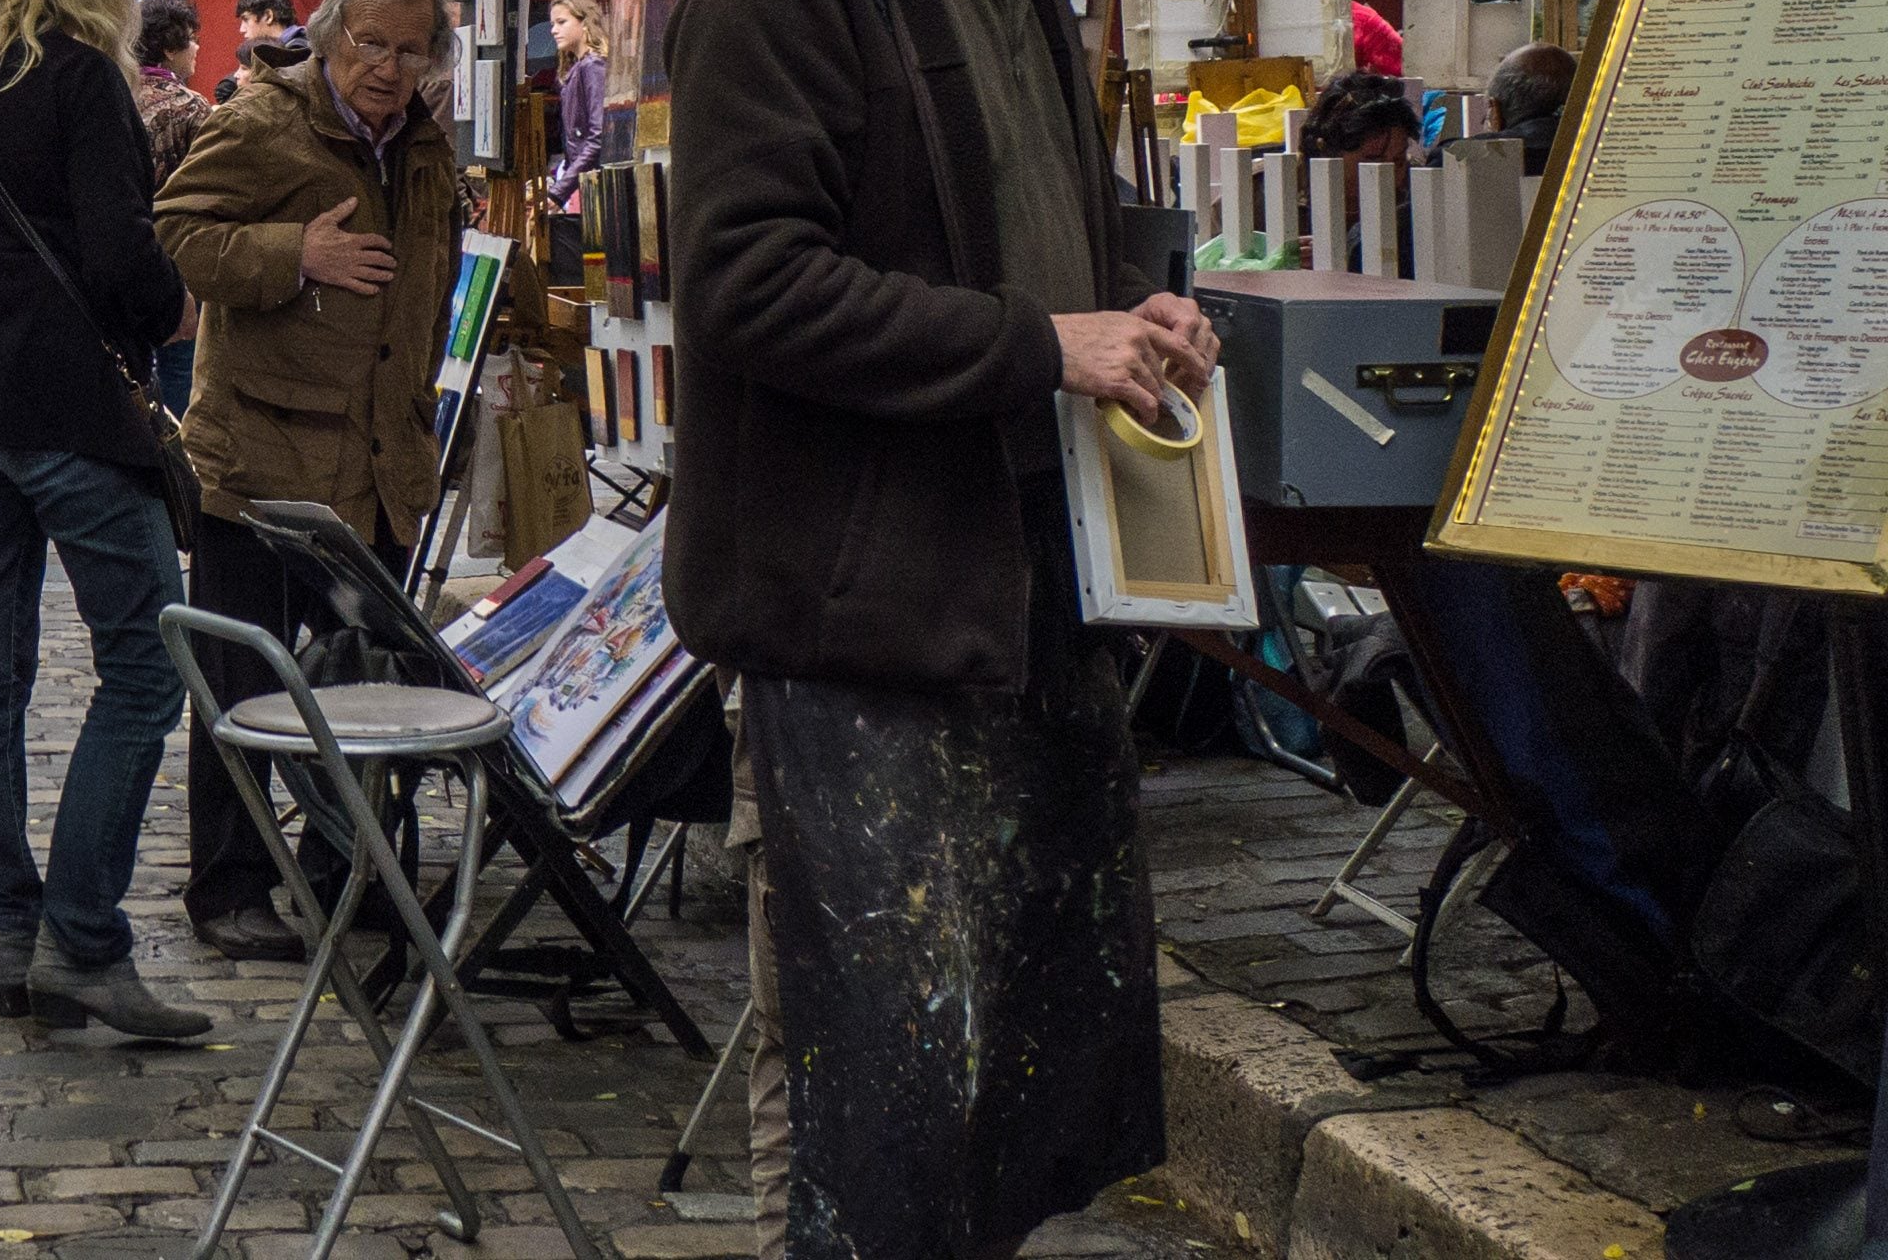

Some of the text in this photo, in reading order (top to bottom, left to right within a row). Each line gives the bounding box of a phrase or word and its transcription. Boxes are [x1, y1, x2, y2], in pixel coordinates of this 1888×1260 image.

[1750, 191, 1800, 207] Fromages
[1685, 350, 1761, 370] Chez Eugène
[1681, 385, 1753, 402] Crêpes Sucrées
[1532, 396, 1594, 412] Crêpes Salées
